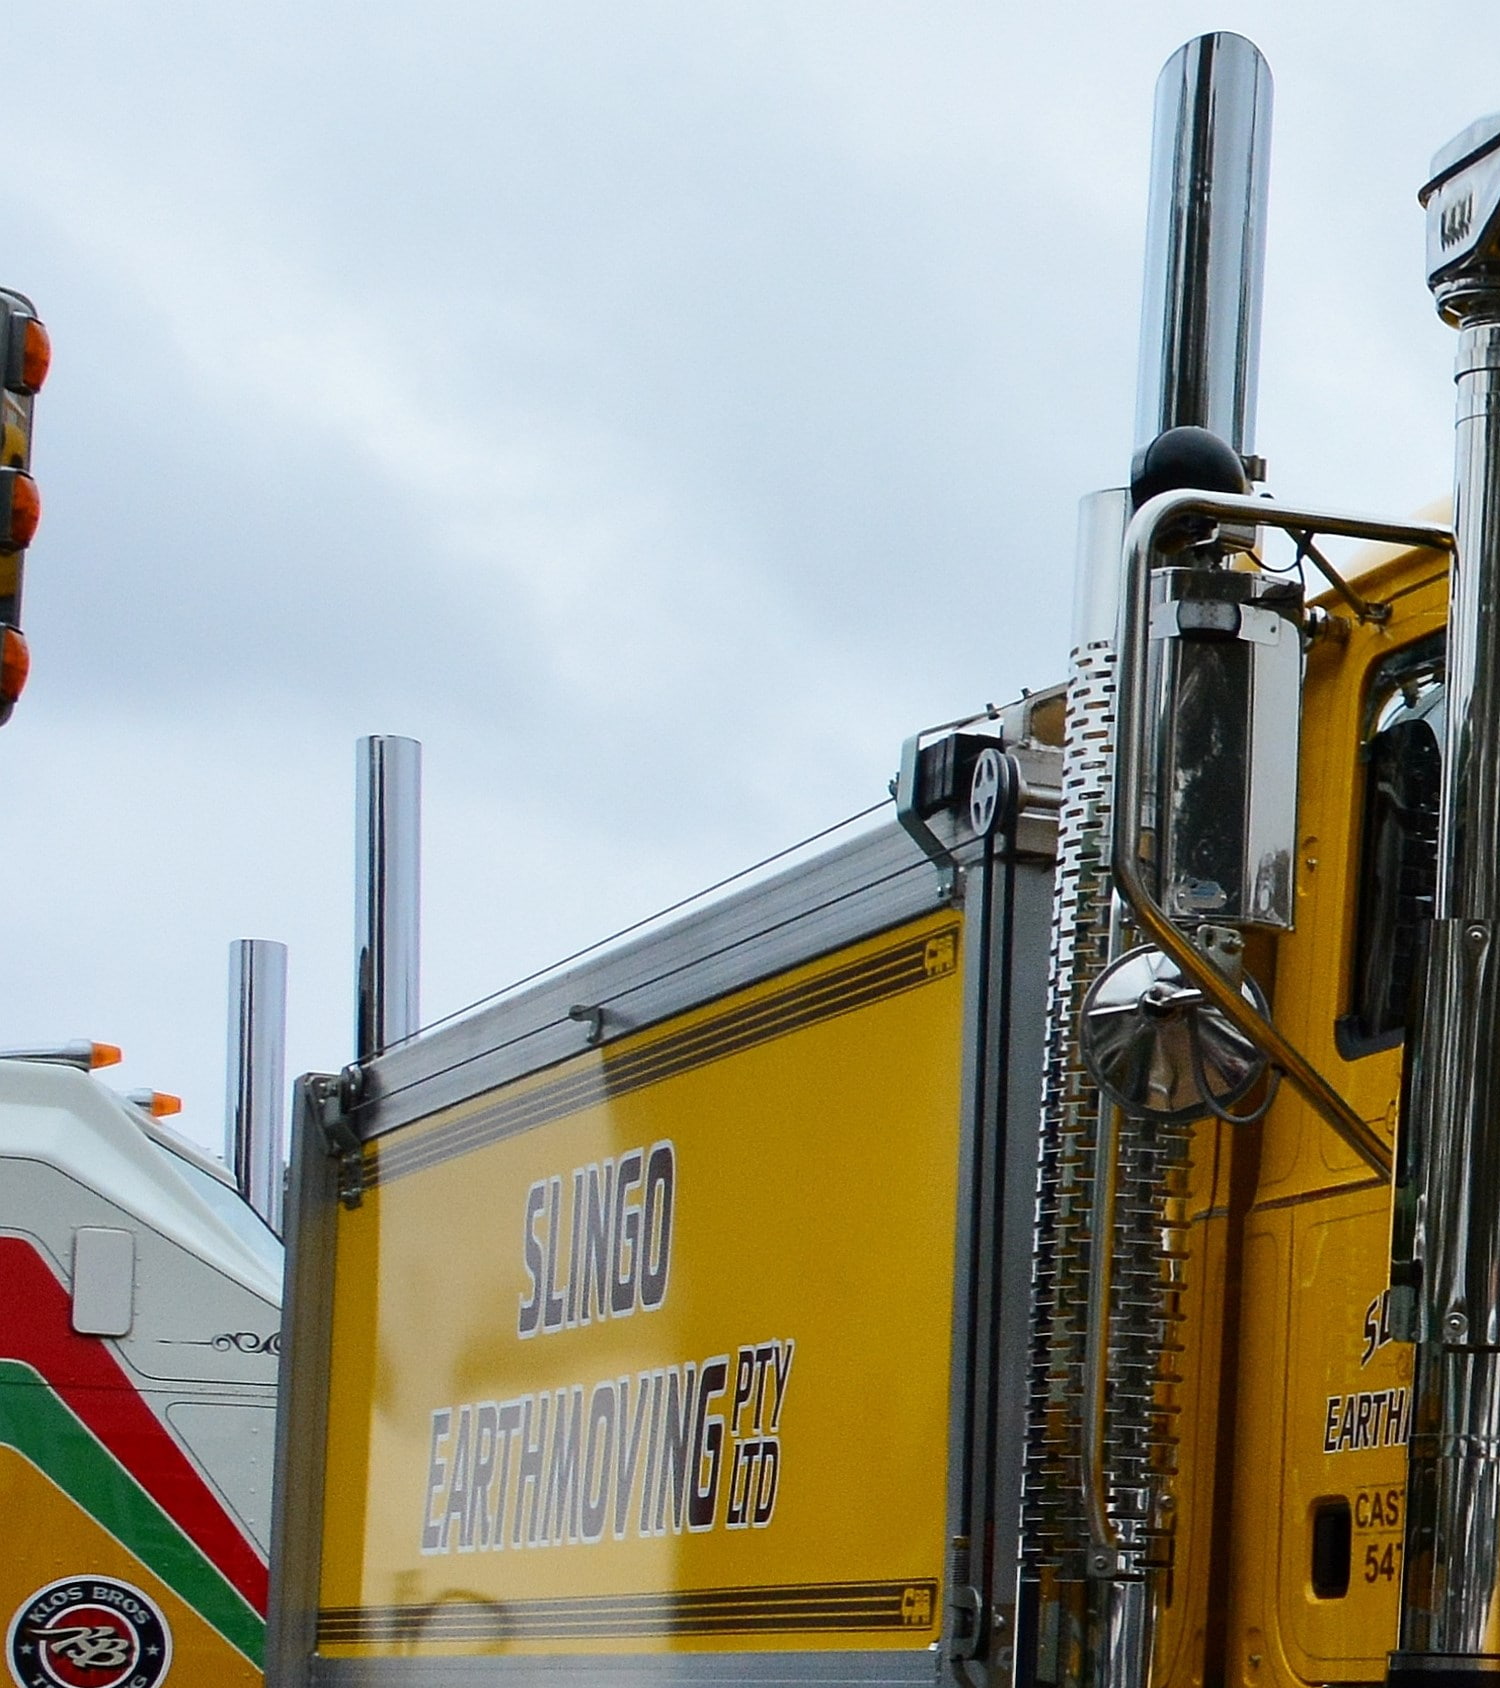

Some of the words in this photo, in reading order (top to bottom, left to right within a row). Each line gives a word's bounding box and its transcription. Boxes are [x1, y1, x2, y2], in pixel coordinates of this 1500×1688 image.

[517, 1138, 675, 1339] SLINGO
[1361, 1290, 1392, 1370] SL
[730, 1337, 796, 1437] PTY
[1324, 1387, 1411, 1455] EARTH
[419, 1352, 731, 1556] EARTHMOVING
[725, 1436, 781, 1530] LTD
[1355, 1489, 1404, 1528] CAS
[1364, 1543, 1403, 1583] 54
[29, 1586, 83, 1623] KLOS
[93, 1586, 150, 1625] BROS
